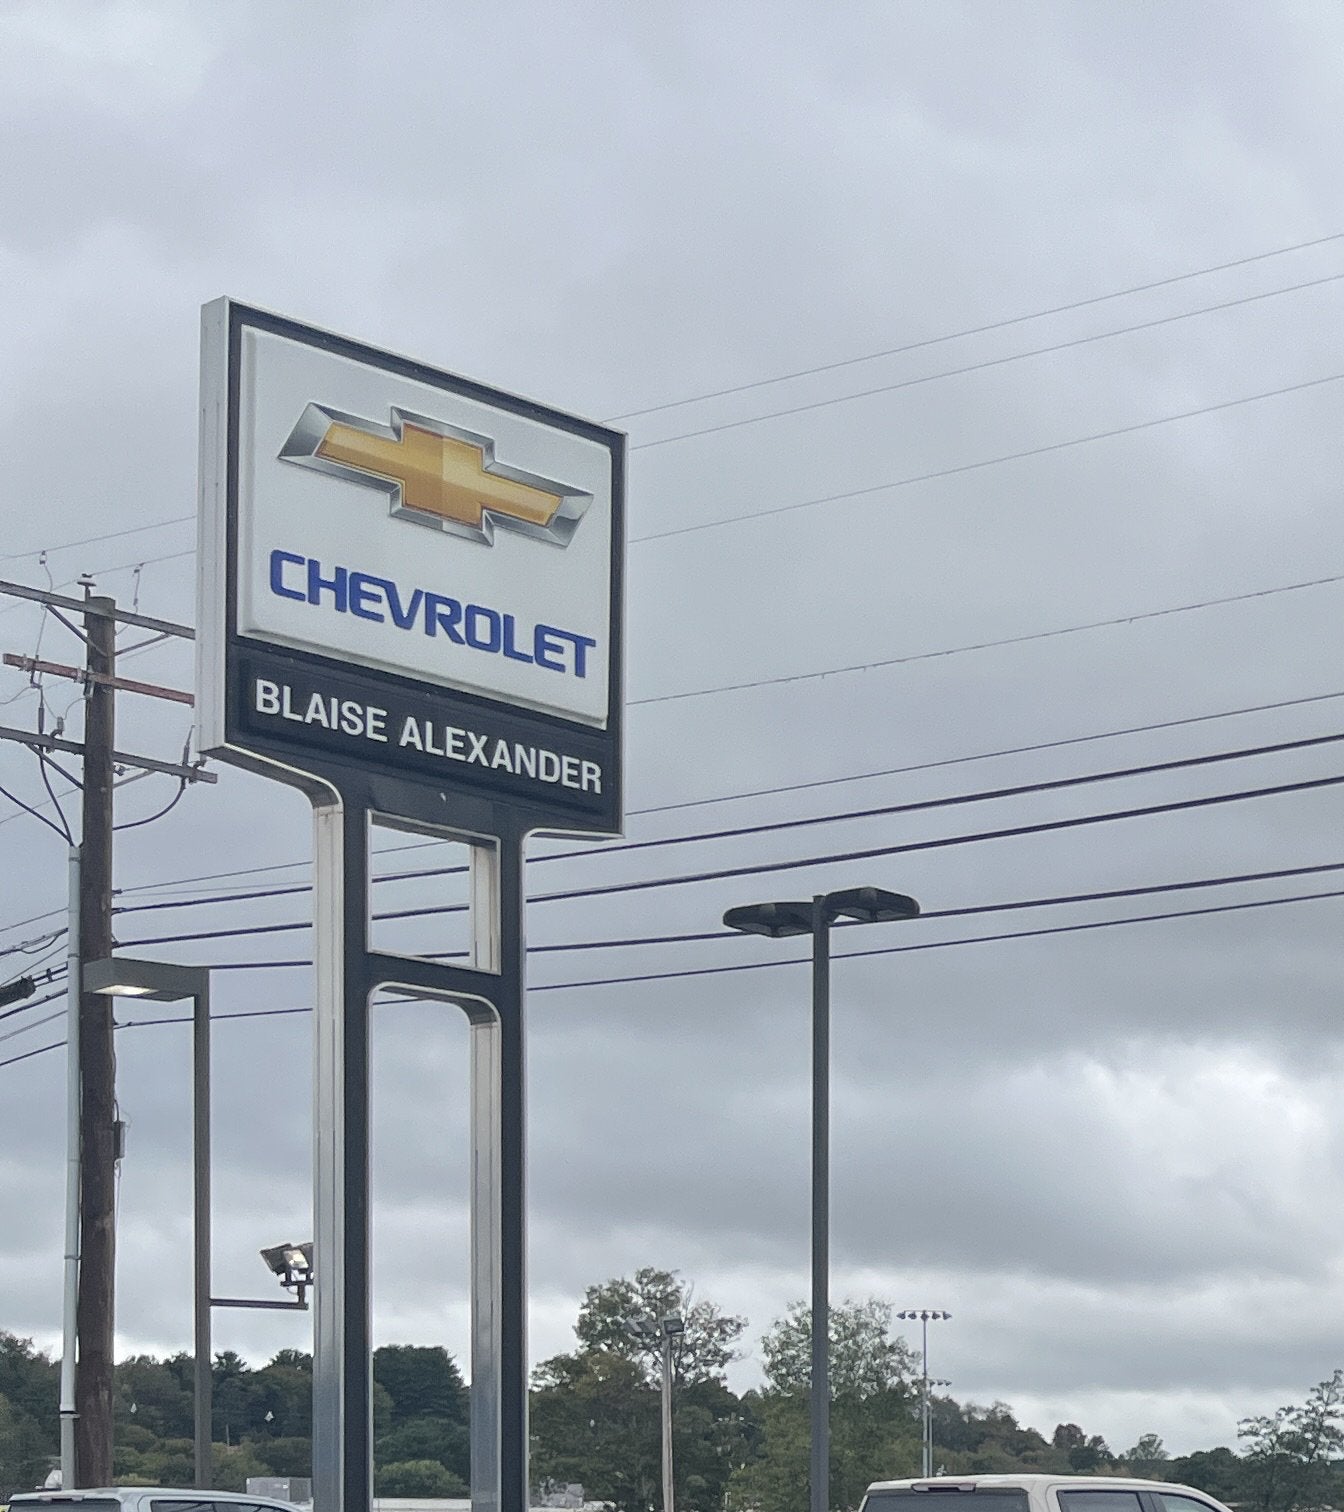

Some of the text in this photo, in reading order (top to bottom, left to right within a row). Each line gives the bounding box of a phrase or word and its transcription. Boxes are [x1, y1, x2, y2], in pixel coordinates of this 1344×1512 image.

[269, 549, 596, 679] CHEVROLET
[255, 678, 602, 794] BLAISE ALEXANDER
